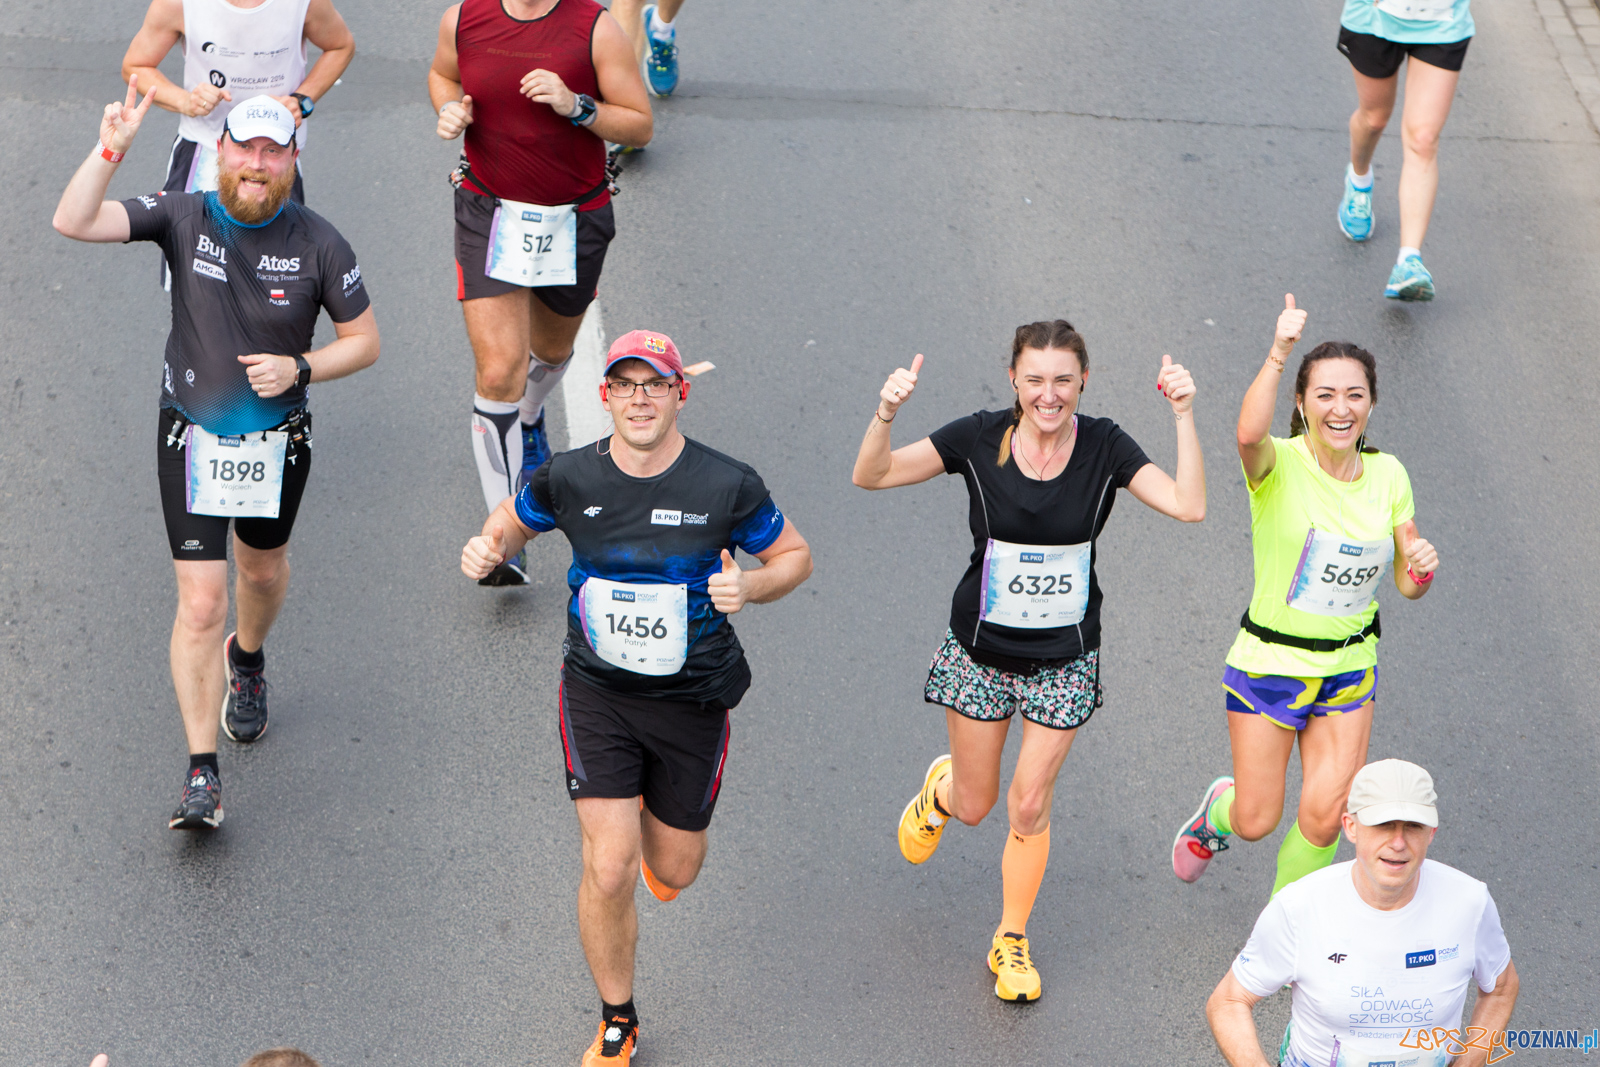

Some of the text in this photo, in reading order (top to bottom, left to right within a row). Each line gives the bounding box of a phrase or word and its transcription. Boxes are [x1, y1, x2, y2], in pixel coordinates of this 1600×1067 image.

[522, 233, 553, 254] 512
[257, 254, 301, 272] Atos
[257, 272, 299, 282] Racing Team
[209, 458, 266, 482] 1898
[220, 483, 252, 491] Wojciech
[583, 505, 603, 517] 4F
[664, 513, 679, 522] PKO
[1320, 563, 1379, 587] 5659
[1008, 573, 1073, 596] 6325
[605, 613, 668, 639] 1456
[624, 638, 648, 648] Patryk
[1327, 952, 1348, 964] 4F
[1350, 985, 1385, 998] SIŁA
[1360, 998, 1434, 1012] ODWAGA
[1349, 1009, 1434, 1024] SZYBKOŚĆ
[1357, 1030, 1409, 1039] październik
